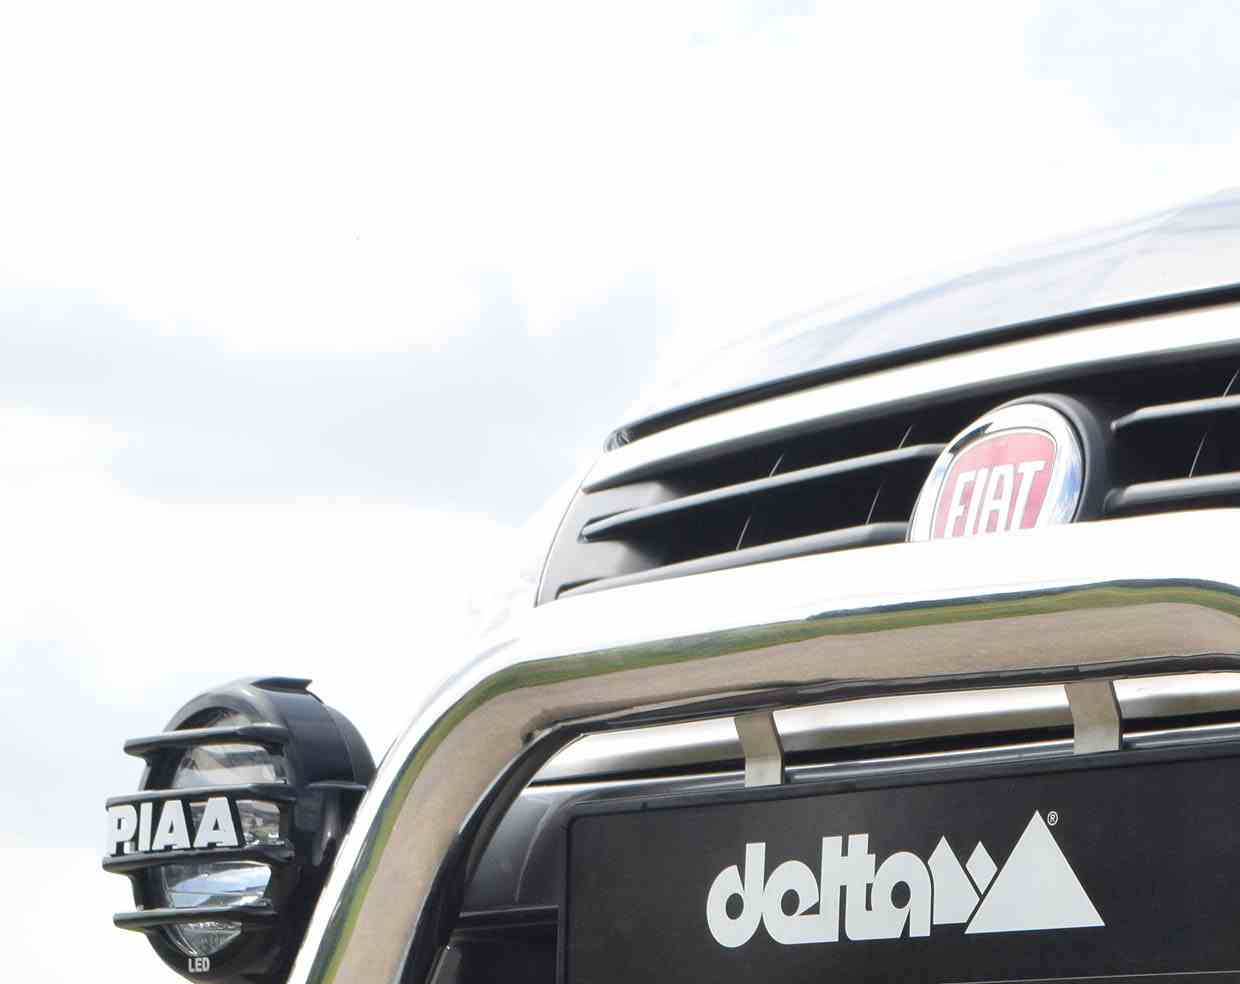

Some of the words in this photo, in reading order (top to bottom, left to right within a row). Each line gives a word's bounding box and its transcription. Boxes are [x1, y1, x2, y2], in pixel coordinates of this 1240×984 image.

[943, 460, 1047, 538] FIAT
[107, 796, 239, 856] PIAA
[706, 833, 931, 948] delta
[188, 957, 210, 973] LED
